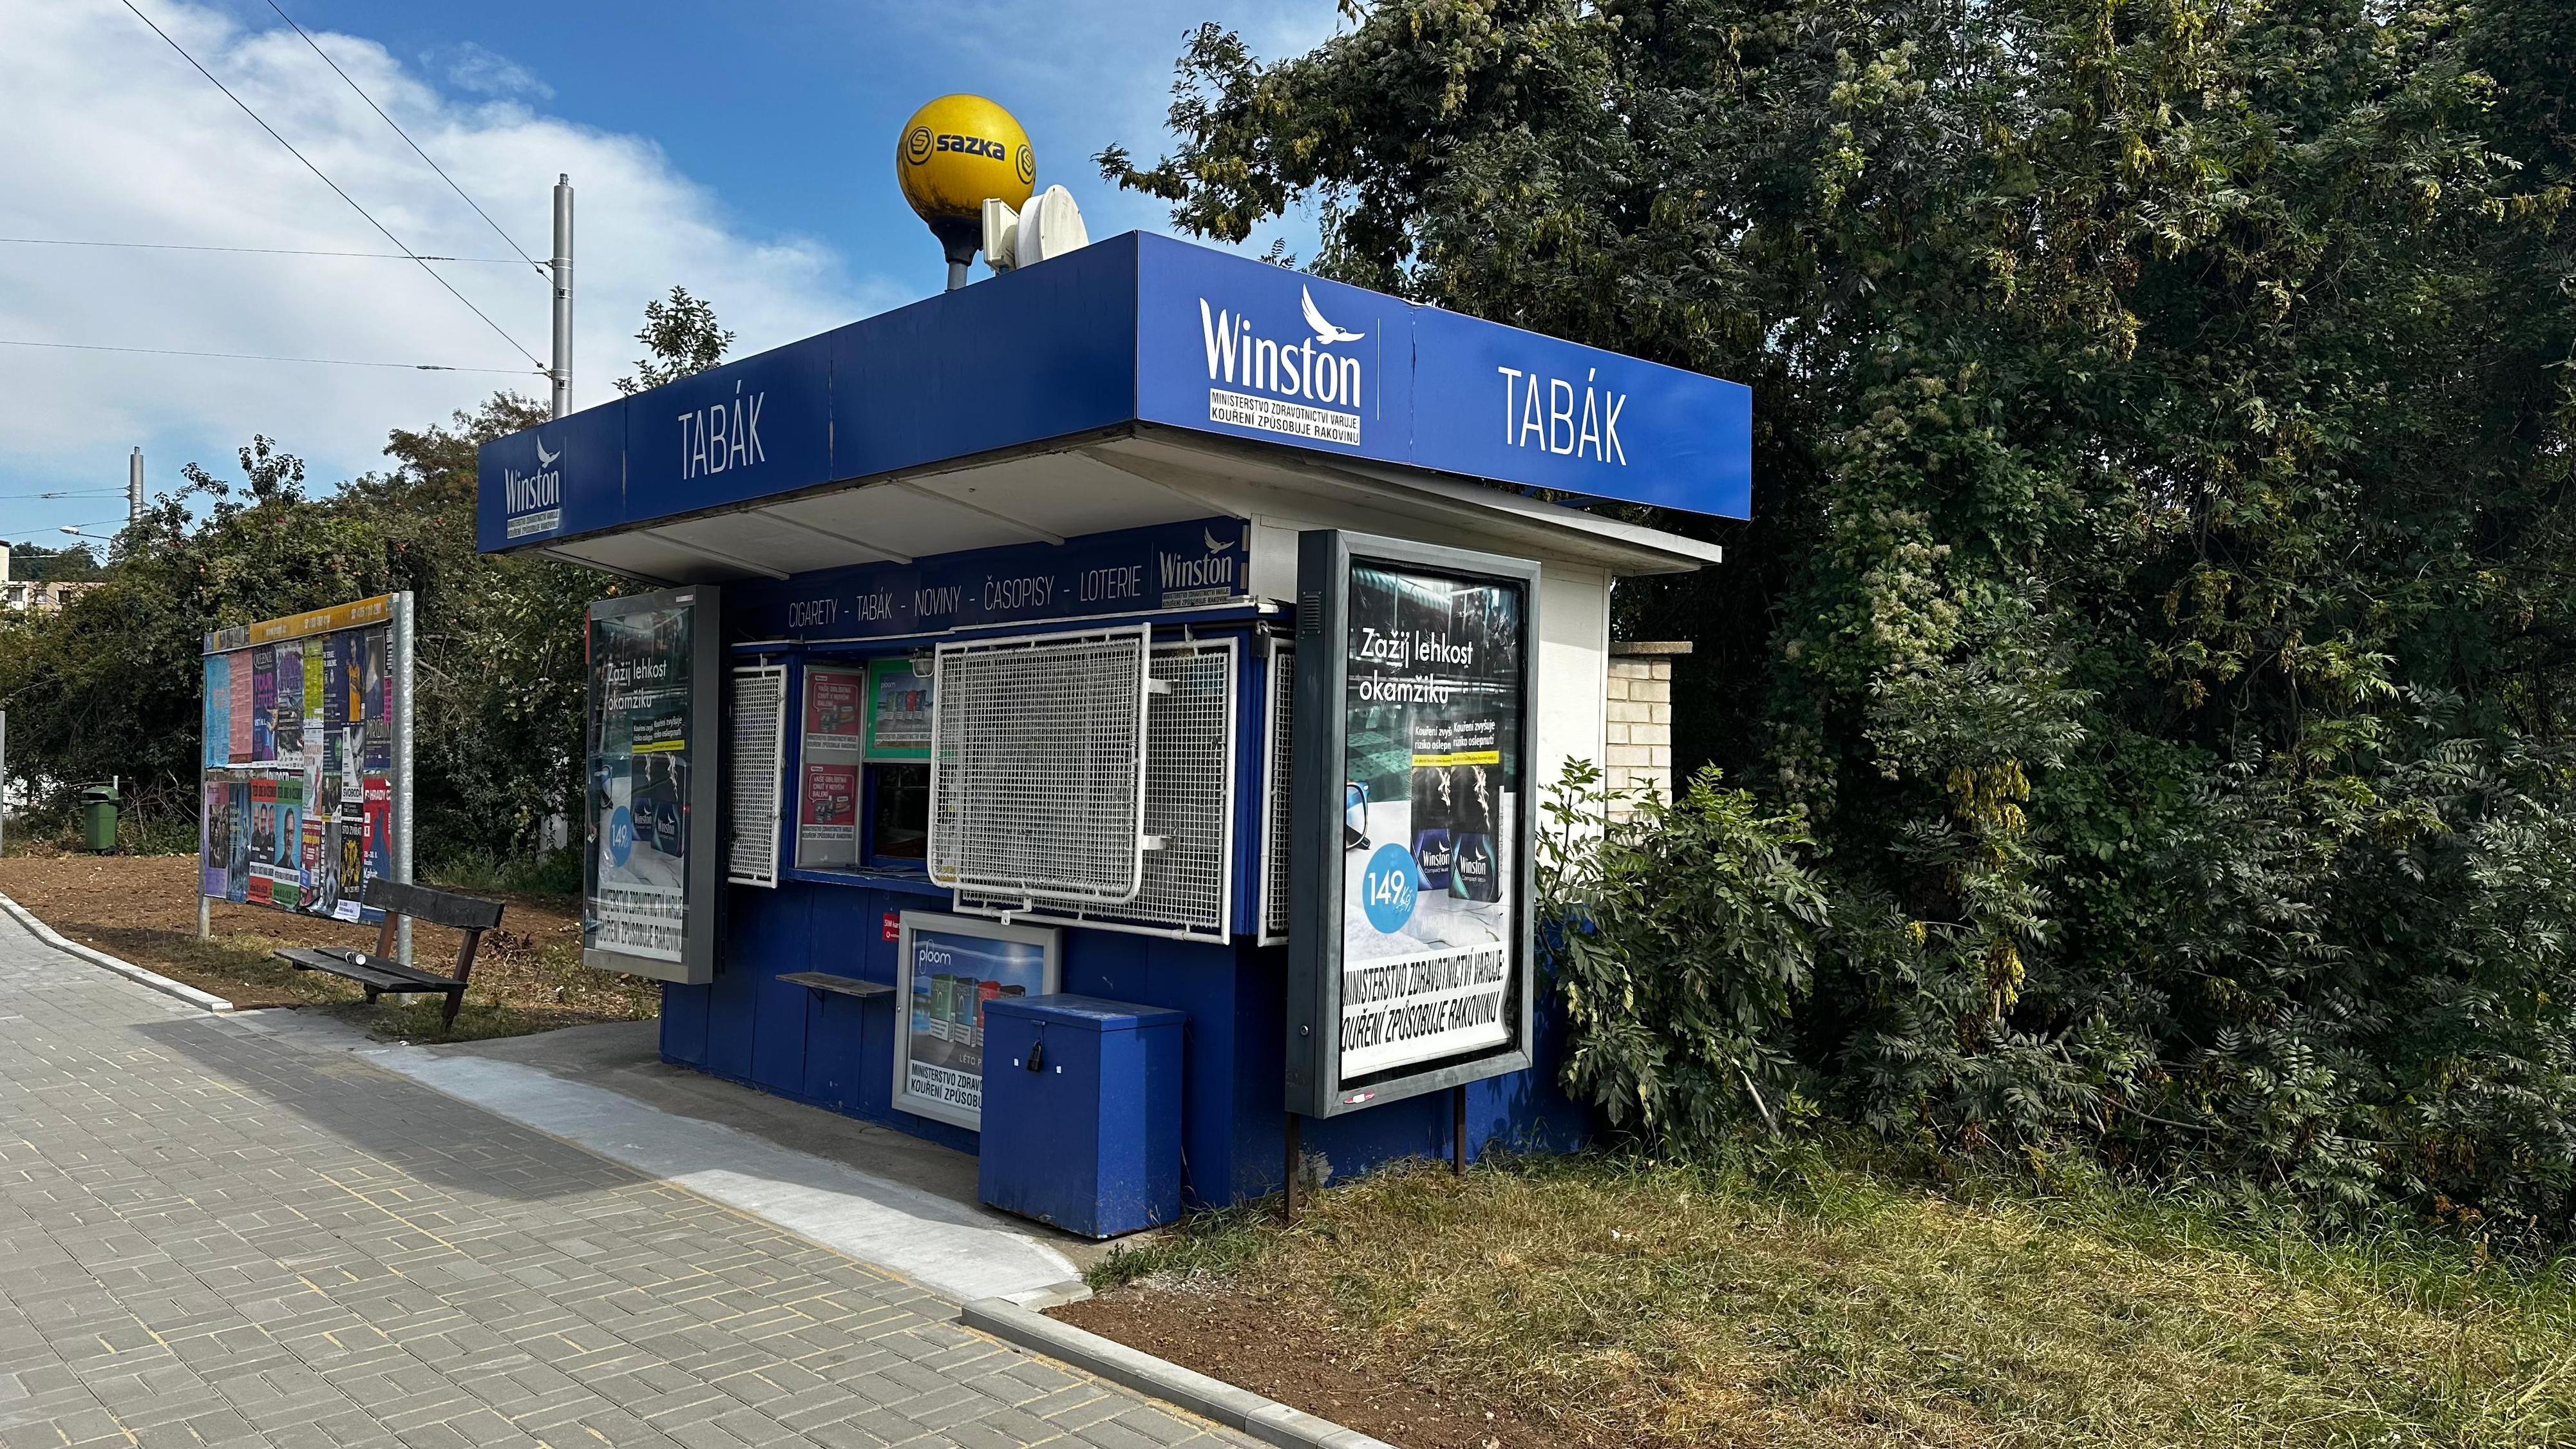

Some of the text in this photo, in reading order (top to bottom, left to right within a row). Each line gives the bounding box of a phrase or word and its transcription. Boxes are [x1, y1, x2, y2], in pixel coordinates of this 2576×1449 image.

[1200, 297, 1361, 408] Winston
[1212, 392, 1269, 413] MINISTERSTVO
[1271, 402, 1329, 424] ZDRAVOTNICTVÍ
[1498, 366, 1627, 466] TABÁK
[678, 379, 765, 480] TABÁK
[1212, 406, 1359, 443] KOUŘENÍ ZPŮSOBUJE RAKOVINU
[505, 468, 559, 514] Winston
[1160, 551, 1232, 589] Winston
[789, 598, 838, 628] CIGARETY
[857, 587, 893, 621] TABÁK
[914, 585, 961, 617] NOVINY
[984, 574, 1054, 611] ČASOPISY
[1080, 565, 1142, 601] LOTERIE
[1361, 627, 1473, 668] Zažij lehkost
[608, 657, 667, 687] Zažij lehkost
[1359, 669, 1449, 703] okamžiku
[608, 687, 652, 711] okamžiku
[1415, 725, 1437, 736] Kouření
[1453, 734, 1495, 748] riziko oslepnutí
[1454, 719, 1495, 733] Kouření zvyšuje
[1415, 739, 1430, 750] riziko
[634, 813, 652, 825] Winston
[658, 819, 675, 835] Winston
[612, 824, 627, 847] 149
[1423, 850, 1450, 867] Winston
[1460, 855, 1486, 875] Winston
[1368, 869, 1405, 906] 149
[621, 916, 653, 949] ZPŮSOBUJE
[919, 939, 951, 974] ploom
[1343, 962, 1407, 1007] MINISTERSTVO
[1408, 947, 1473, 996] ZDRAVOTNICTVÍ
[1342, 990, 1500, 1052] OUŘENÍ ZPŮSOBUJE RAKOVINU
[911, 1078, 943, 1099] KOUŘENÍ
[912, 1063, 956, 1086] MINISTERSTVO
